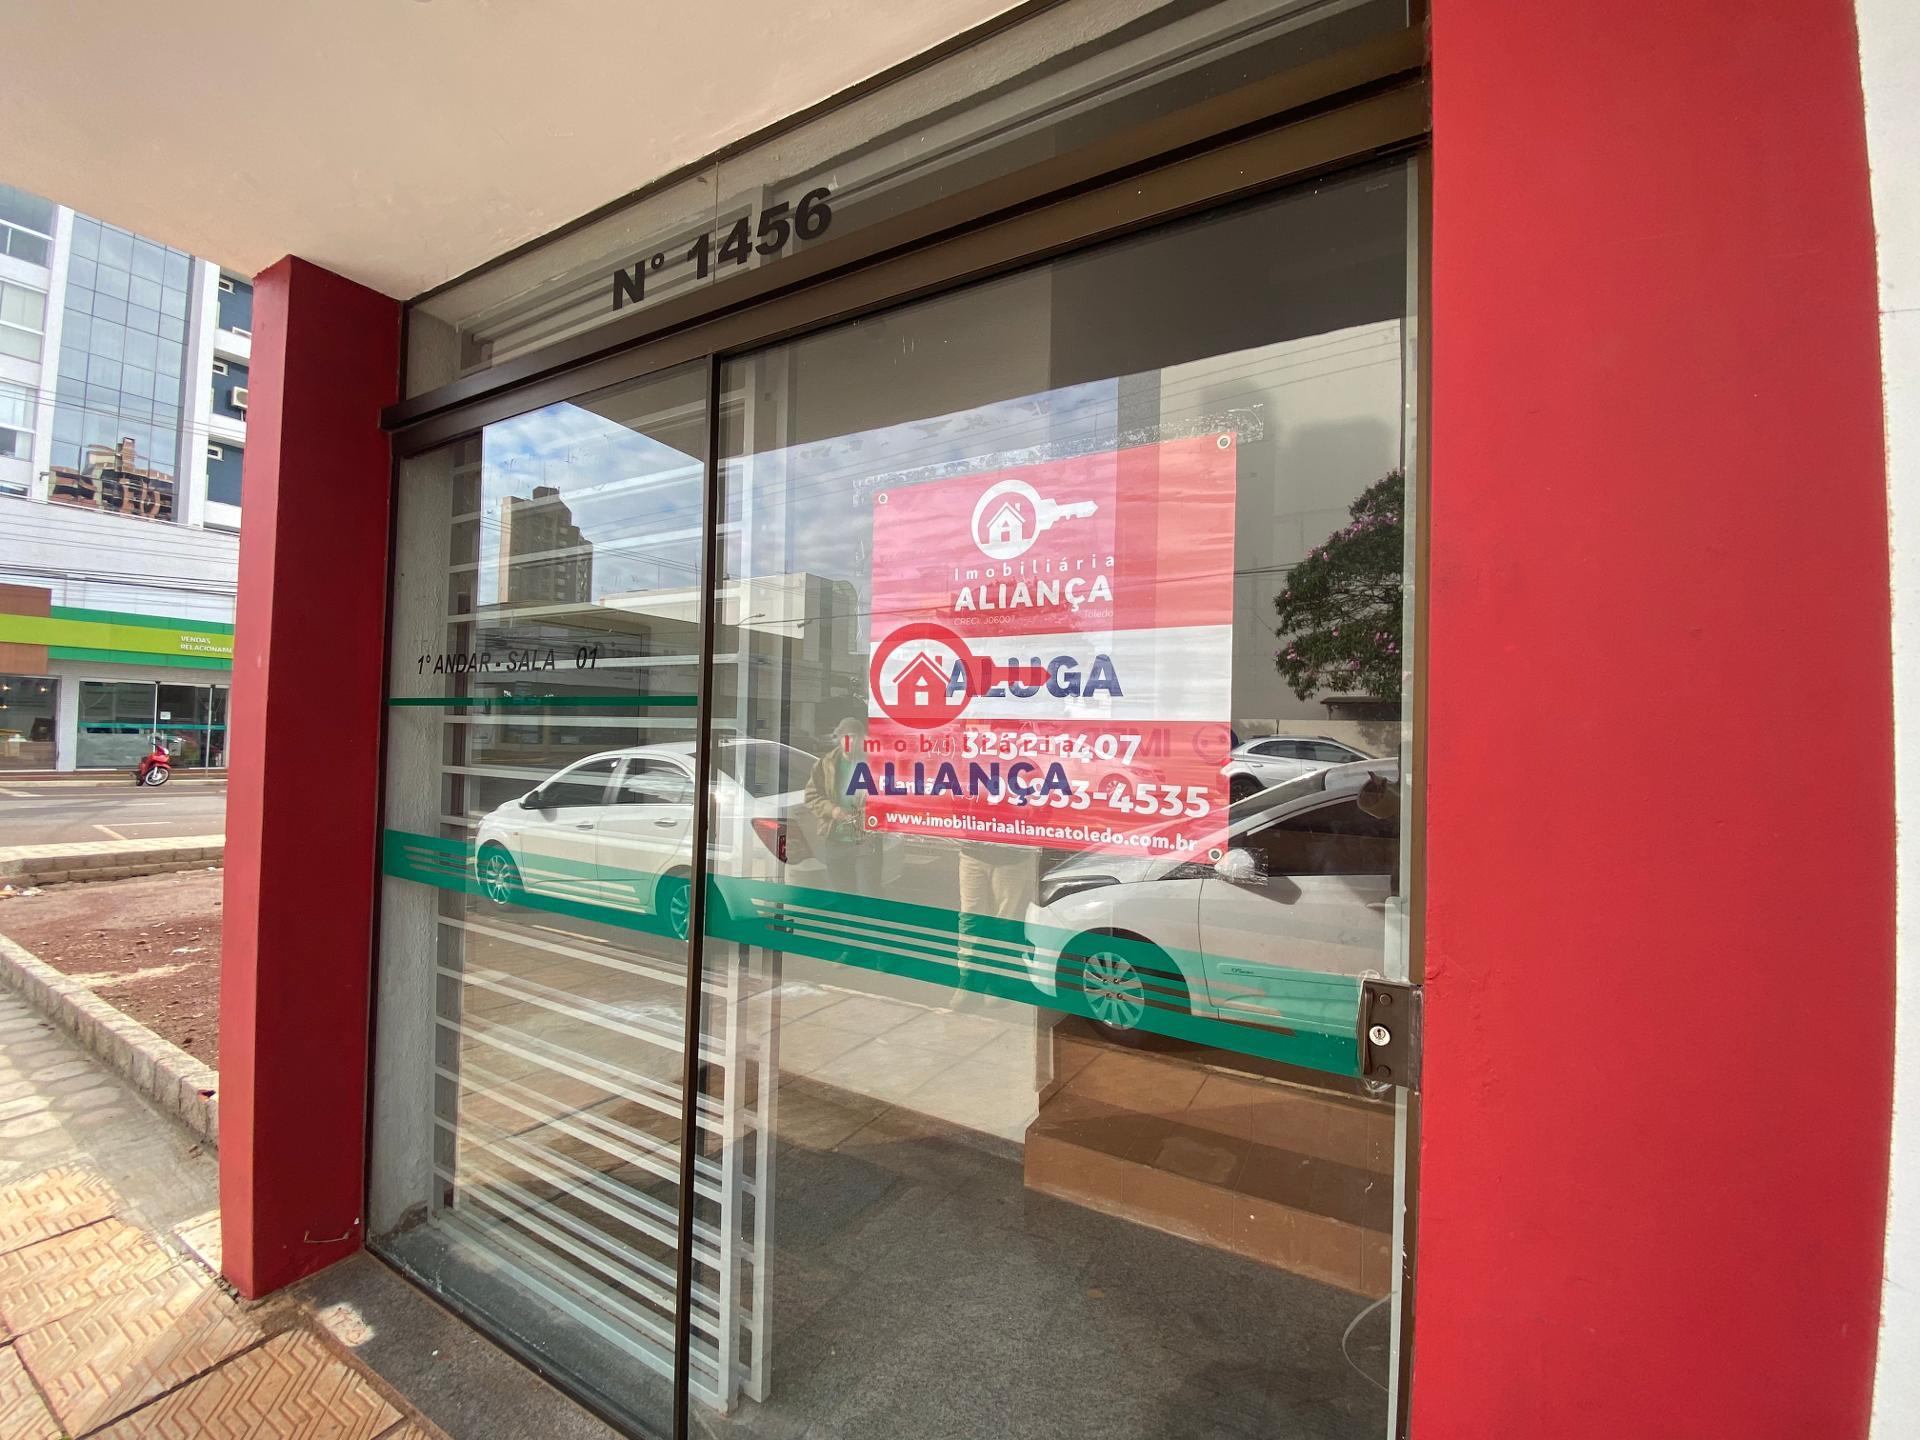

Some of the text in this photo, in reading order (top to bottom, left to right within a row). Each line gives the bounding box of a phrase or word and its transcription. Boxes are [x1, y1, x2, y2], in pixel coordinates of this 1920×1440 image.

[687, 187, 832, 280] 1456
[954, 554, 1115, 581] Imobiliária
[954, 575, 1113, 612] ALIANÇA
[1083, 609, 1114, 618] Toledo
[181, 635, 211, 644] VENDAS
[433, 652, 492, 675] ANDAR
[506, 649, 556, 672] SALA
[575, 646, 600, 670] 01
[944, 653, 1124, 698] ALUGA
[886, 811, 1199, 851] www.imobiliariaaliancatoledo.com.br
